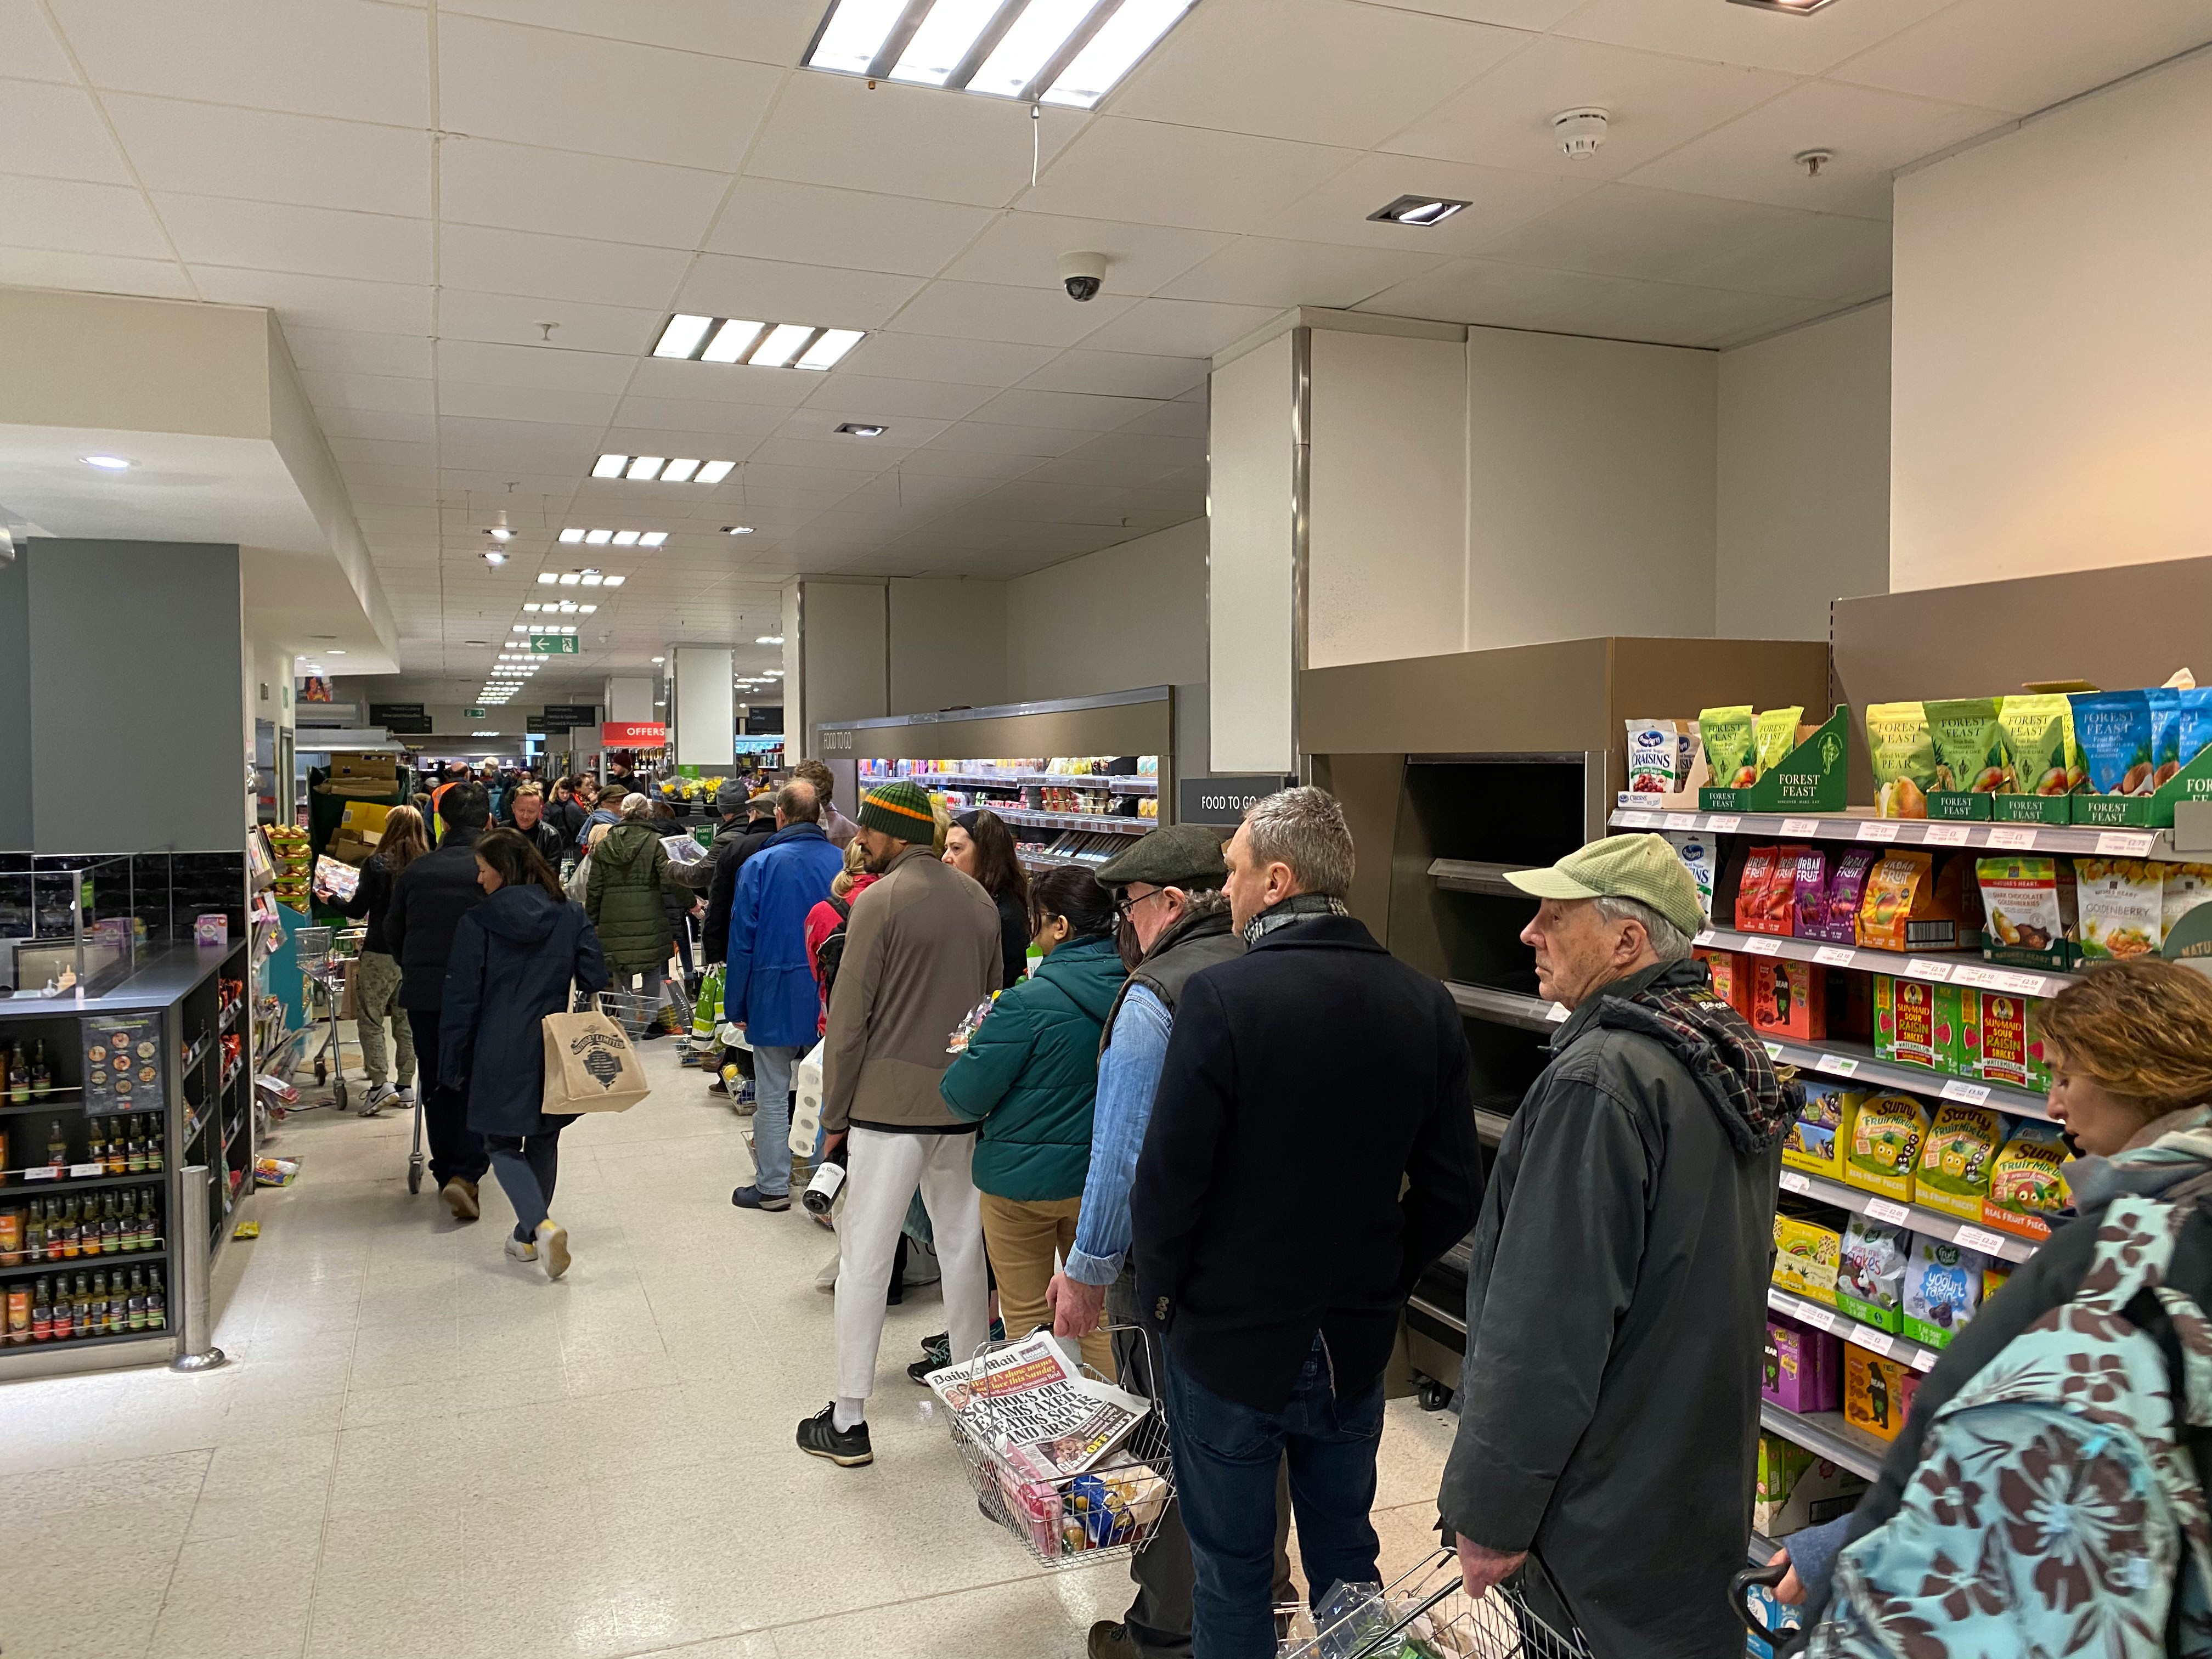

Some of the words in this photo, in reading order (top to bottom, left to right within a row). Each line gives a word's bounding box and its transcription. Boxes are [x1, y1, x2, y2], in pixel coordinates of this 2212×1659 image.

[1941, 717, 1986, 727] FOREST
[2008, 716, 2049, 725] FOREST
[2085, 712, 2134, 723] FOREST
[627, 727, 664, 736] OFFERS
[1708, 724, 1742, 732] FOREST
[1878, 723, 1923, 733] FOREST
[1946, 728, 1981, 737] FEAST
[2010, 726, 2043, 736] FEAST
[2087, 724, 2129, 735] FEAST
[823, 732, 836, 749] FOOD
[837, 732, 843, 749] TO
[844, 732, 851, 749] GO
[1882, 734, 1917, 743] FEAST
[1632, 753, 1670, 768] CRAISINS
[1882, 760, 1912, 769] PEAR
[1779, 774, 1820, 785] FOREST
[1783, 786, 1816, 796] FEAST
[1201, 796, 1225, 809] FOOD
[1227, 796, 1240, 809] TO
[1940, 797, 1973, 806] FOREST
[2009, 801, 2044, 810] FOREST
[1944, 806, 1971, 816] FEAST
[2088, 803, 2128, 812] FOREST
[2013, 810, 2041, 820] FEAST
[2092, 813, 2123, 822] FEAST
[1748, 856, 1770, 867] URBAN
[1798, 857, 1820, 870] URBAN
[1842, 855, 1869, 868] URBAN
[1883, 860, 1915, 871] URBAN
[1745, 867, 1767, 878] FRUIT
[1775, 868, 1796, 878] FRUIT
[1796, 871, 1819, 882] FRUIT
[1837, 866, 1863, 878] FRUIT
[1879, 869, 1911, 885] FRUIT
[1904, 1013, 1922, 1023] SOUR
[1899, 1019, 1928, 1035] RAISIN
[1904, 1032, 1923, 1043] SNACKS
[1993, 1029, 2013, 1038] SOUR
[1898, 1042, 1929, 1053] WATERMELON
[1987, 1035, 2021, 1052] RAISIN
[1992, 1048, 2016, 1060] SNACKS
[1987, 1059, 2022, 1071] WATERMELON
[1877, 1100, 1916, 1120] Sunny
[1942, 1107, 1991, 1131] Sunny
[1864, 1172, 1881, 1183] FRUIT
[1889, 1209, 1903, 1217] £2.05
[1984, 1208, 2001, 1220] REAL
[2002, 1212, 2024, 1224] FRUIT
[2026, 1217, 2051, 1233] PIECE
[1981, 1237, 1997, 1246] £2.20
[1939, 1248, 1956, 1259] fruit
[1926, 1272, 1965, 1297] yogurt
[932, 1370, 973, 1385] Daily
[986, 1354, 1018, 1369] Mail
[971, 1380, 983, 1388] We
[1005, 1366, 1026, 1378] show
[1027, 1358, 1053, 1372] mums
[991, 1380, 1008, 1390] love
[1009, 1374, 1025, 1385] this
[1025, 1365, 1056, 1382] Sunday
[1022, 1376, 1048, 1388] Susanna
[1046, 1370, 1061, 1380] Reid
[962, 1390, 1039, 1423] SCHOOL'S
[1039, 1380, 1074, 1399] OUT,
[972, 1404, 1033, 1434] EXAMS
[1035, 1392, 1082, 1413] AXED,
[981, 1413, 1048, 1442] DEATHS
[1047, 1395, 1093, 1421] SOAR
[1006, 1426, 1040, 1444] AND
[1042, 1412, 1086, 1437] ARMY
[1084, 1398, 1103, 1413] IN
[1088, 1417, 1099, 1426] the
[1057, 1413, 1133, 1472] GlastOFFbury
